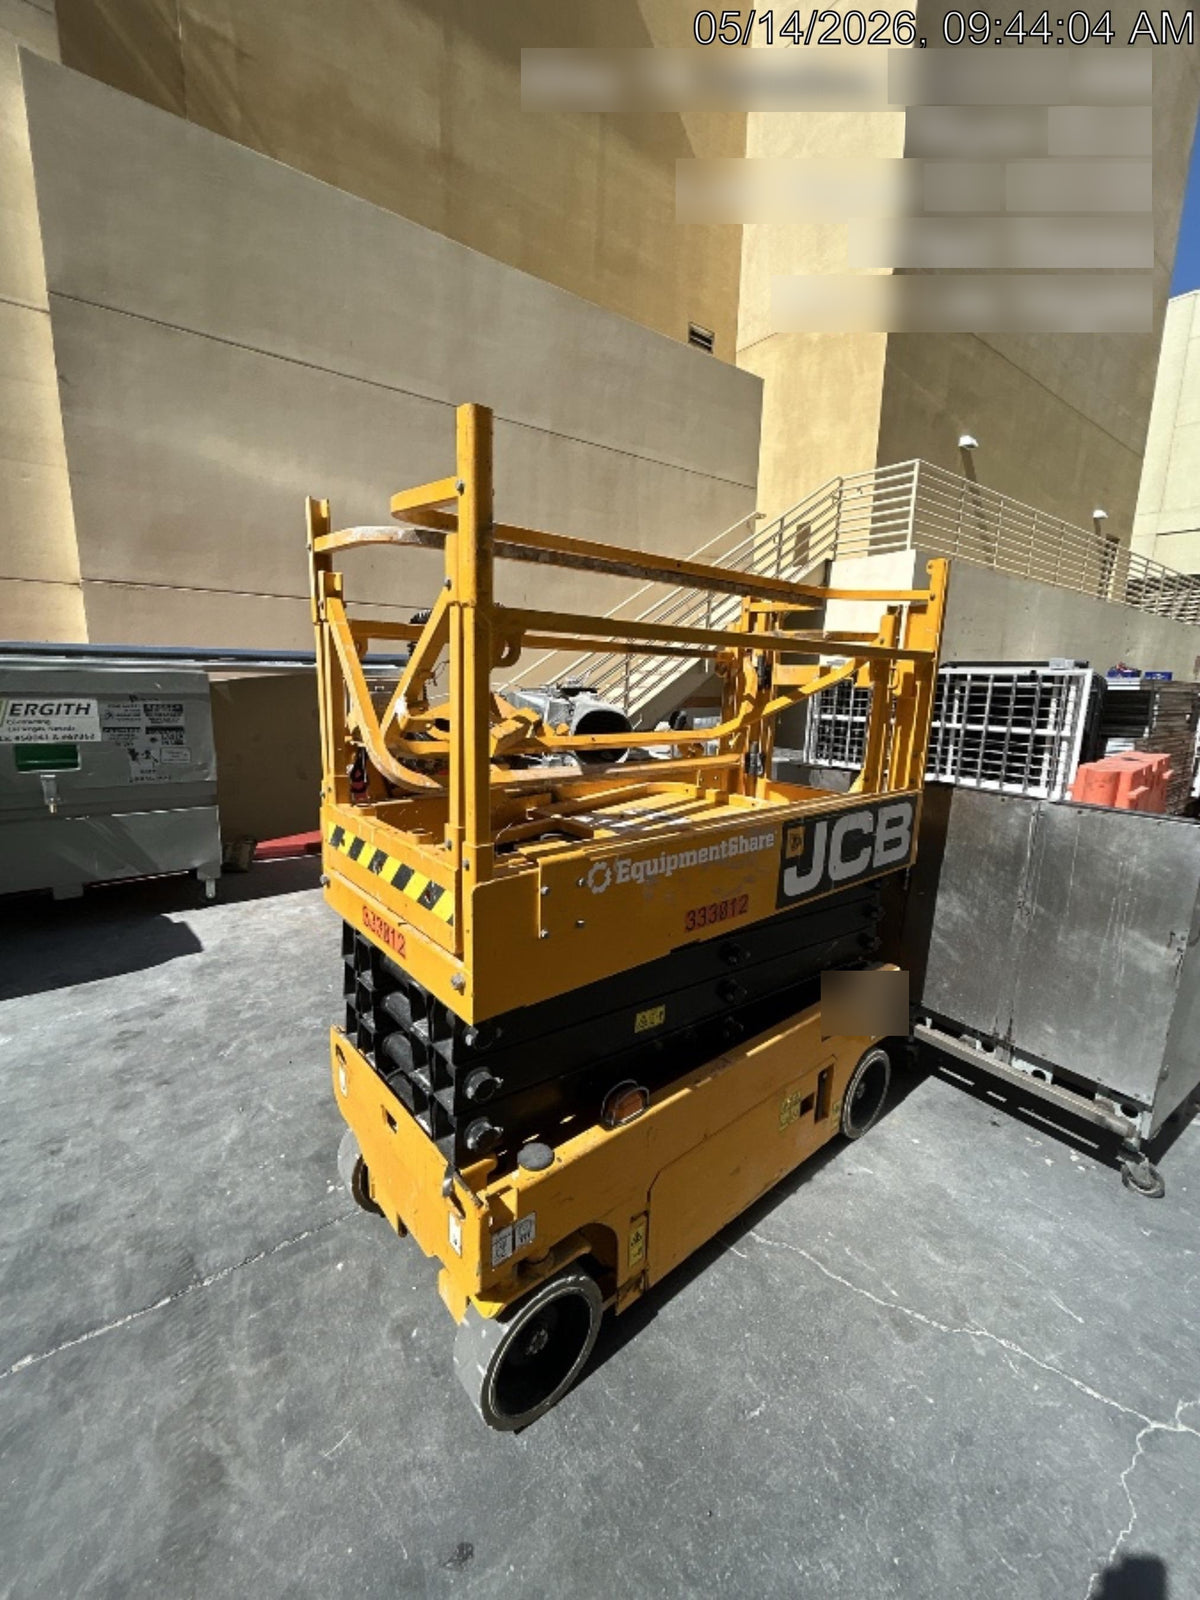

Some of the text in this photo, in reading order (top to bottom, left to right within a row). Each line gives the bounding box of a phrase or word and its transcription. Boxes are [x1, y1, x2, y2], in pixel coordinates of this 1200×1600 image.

[615, 830, 775, 884] EquipmentShare
[783, 802, 913, 897] JCB
[685, 894, 750, 932] 333012
